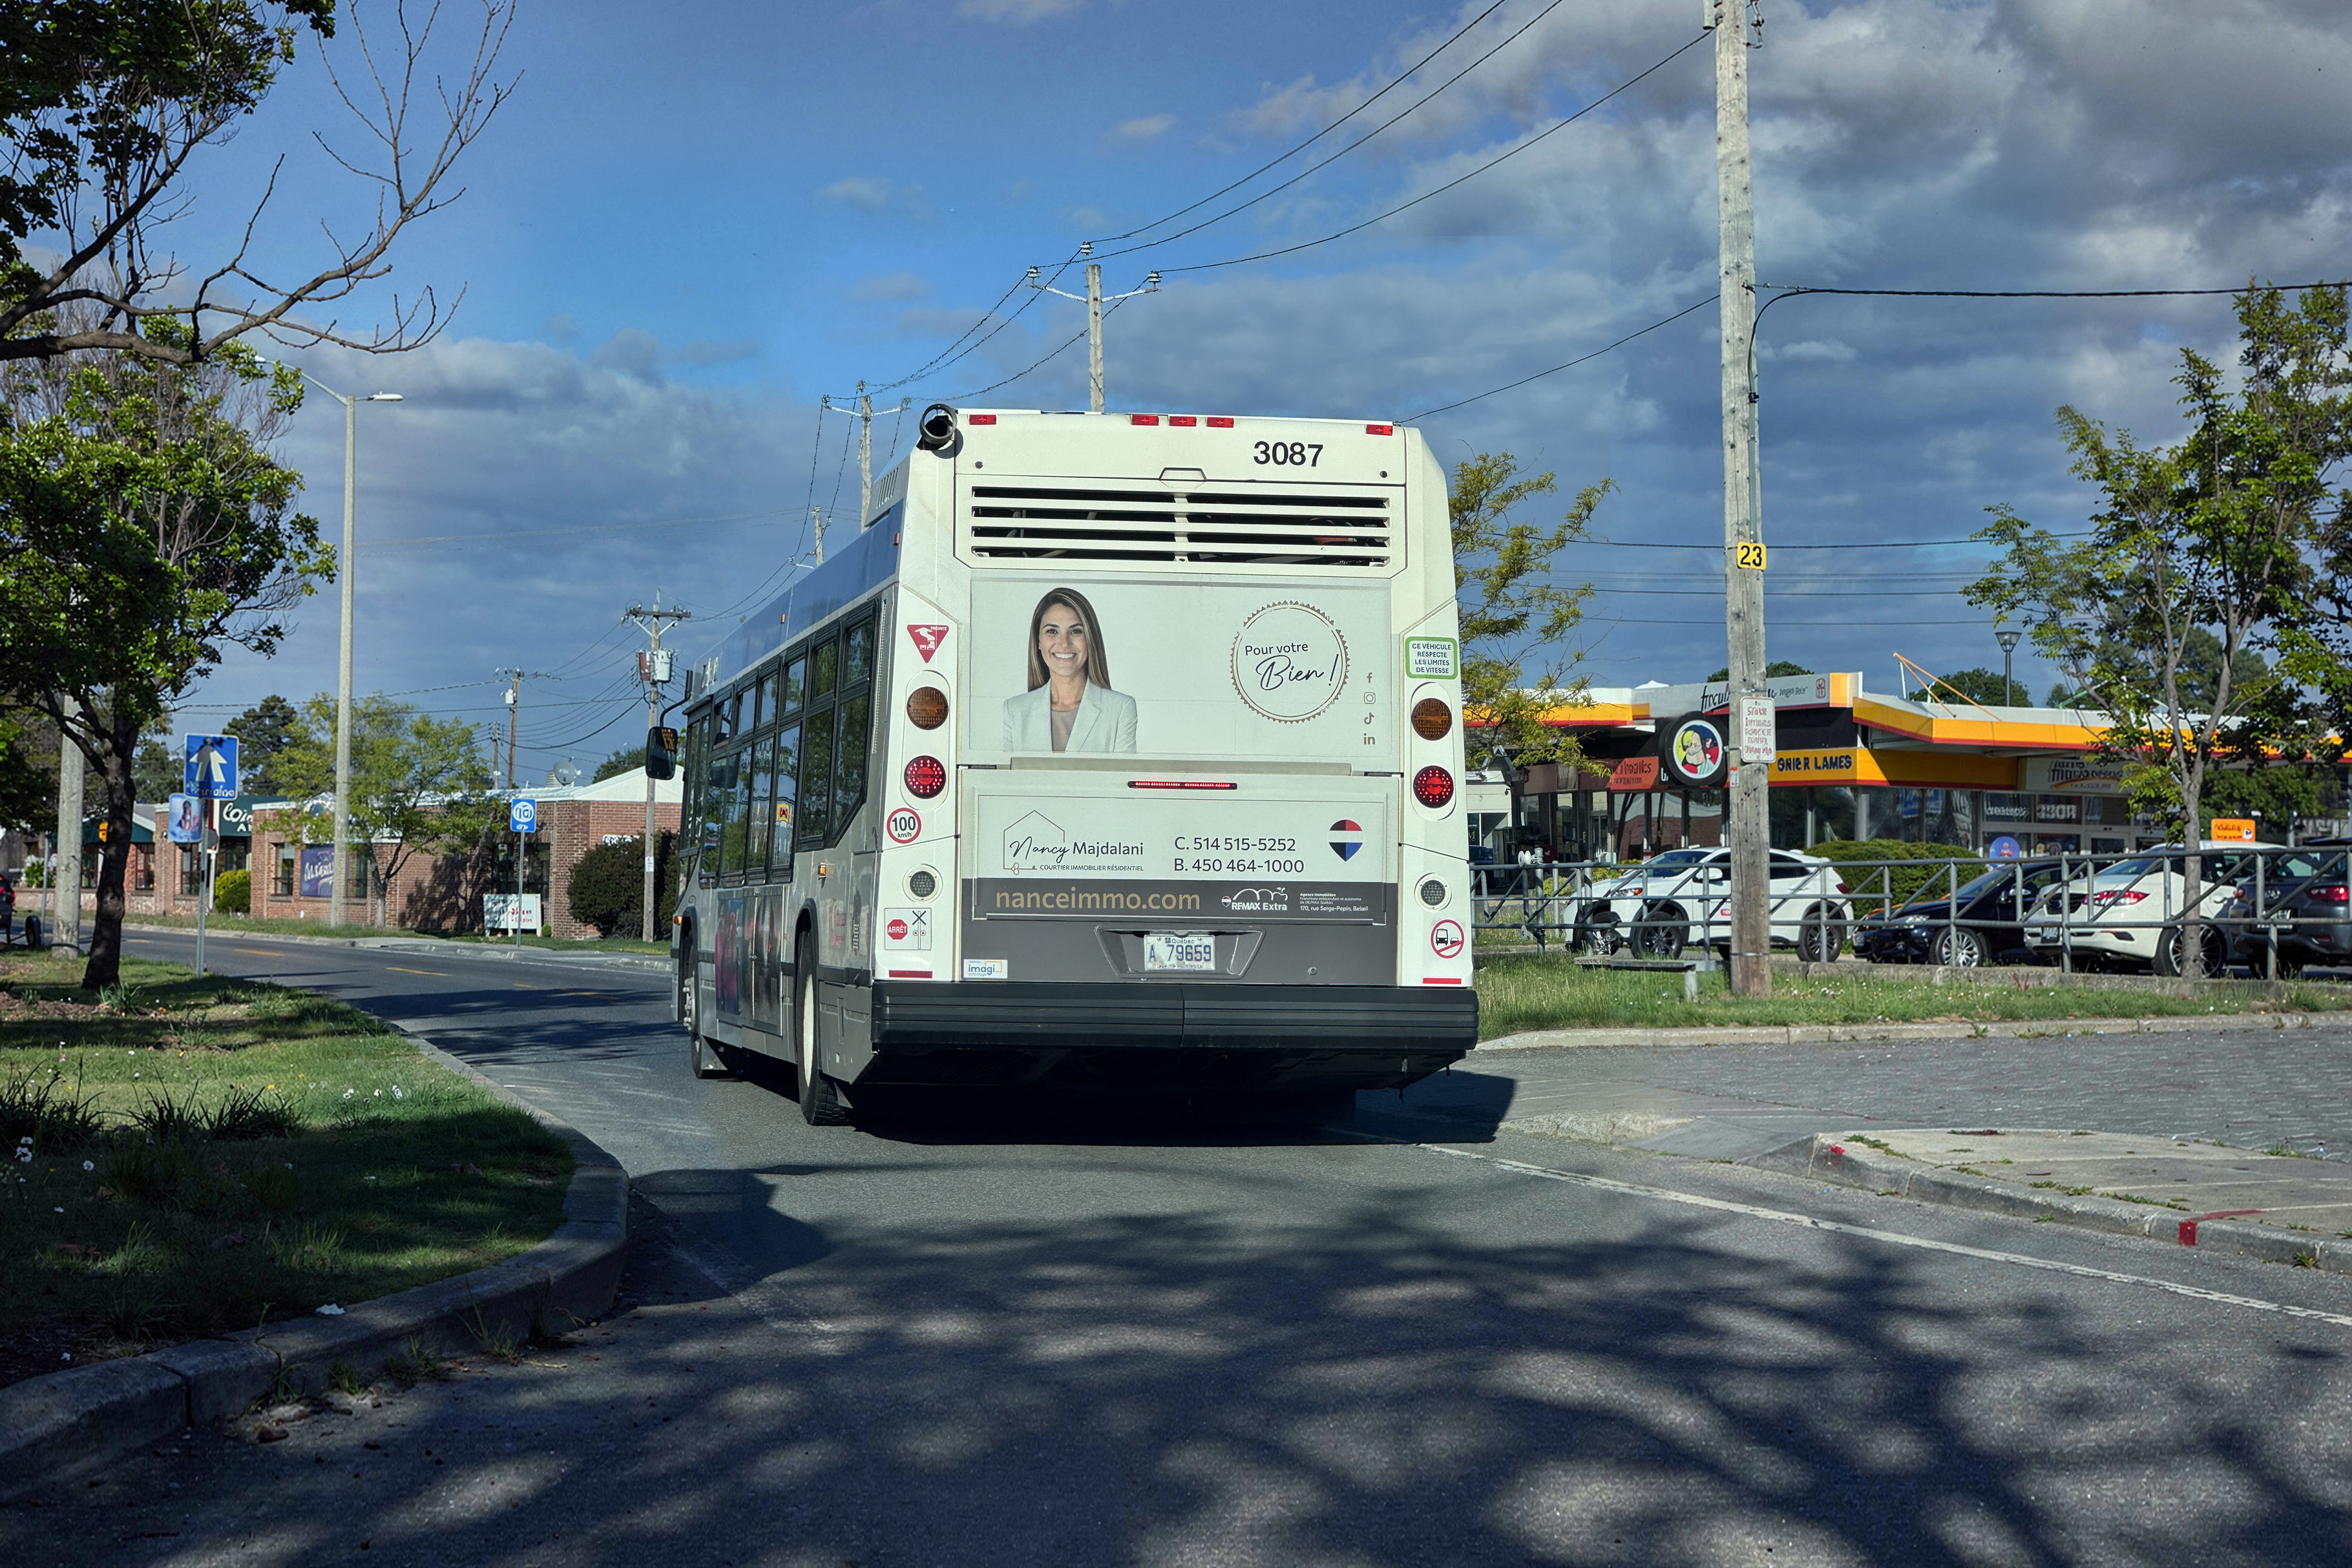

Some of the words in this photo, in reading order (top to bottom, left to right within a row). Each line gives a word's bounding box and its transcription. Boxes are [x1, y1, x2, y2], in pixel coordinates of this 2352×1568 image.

[1254, 441, 1323, 467] 3087
[1740, 545, 1762, 567] 23
[1244, 645, 1274, 656] Pour
[1276, 642, 1308, 654] votre
[892, 816, 916, 831] 100
[1009, 835, 1070, 864] Nancy
[1073, 841, 1144, 857] Majdalani
[1174, 836, 1190, 850] C.
[1193, 837, 1221, 850] 514
[1224, 837, 1296, 852] 515-5252
[1174, 858, 1188, 872] B.
[1192, 859, 1223, 872] 450
[1226, 859, 1305, 873] 464-1000
[996, 886, 1200, 910] nanceimmo.com
[1263, 903, 1287, 911] Extra
[888, 925, 907, 934] ARRÊT
[1149, 945, 1157, 961] A
[1166, 945, 1212, 961] 79659
[969, 965, 995, 976] imagi
